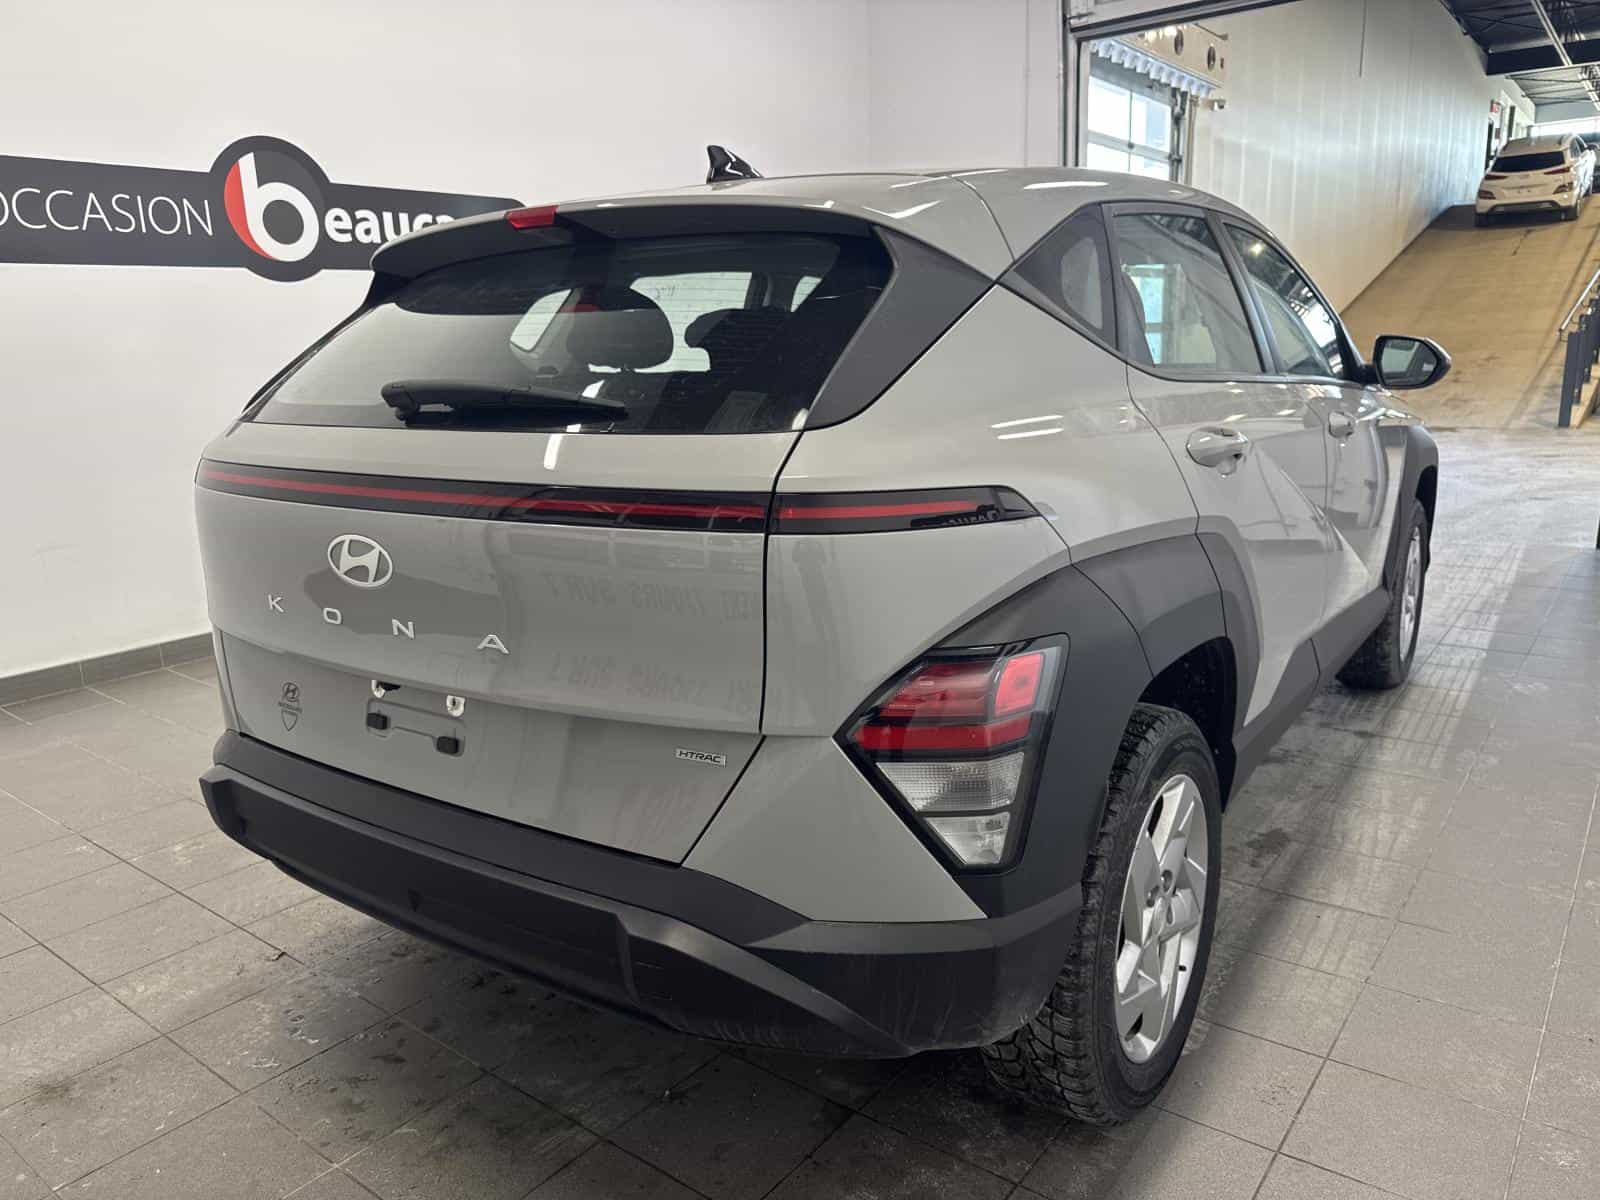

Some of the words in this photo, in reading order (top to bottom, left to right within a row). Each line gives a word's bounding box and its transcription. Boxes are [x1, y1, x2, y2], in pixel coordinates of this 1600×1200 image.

[0, 187, 213, 236] CCASION
[267, 594, 510, 655] KONA
[678, 750, 722, 764] HTRAC
